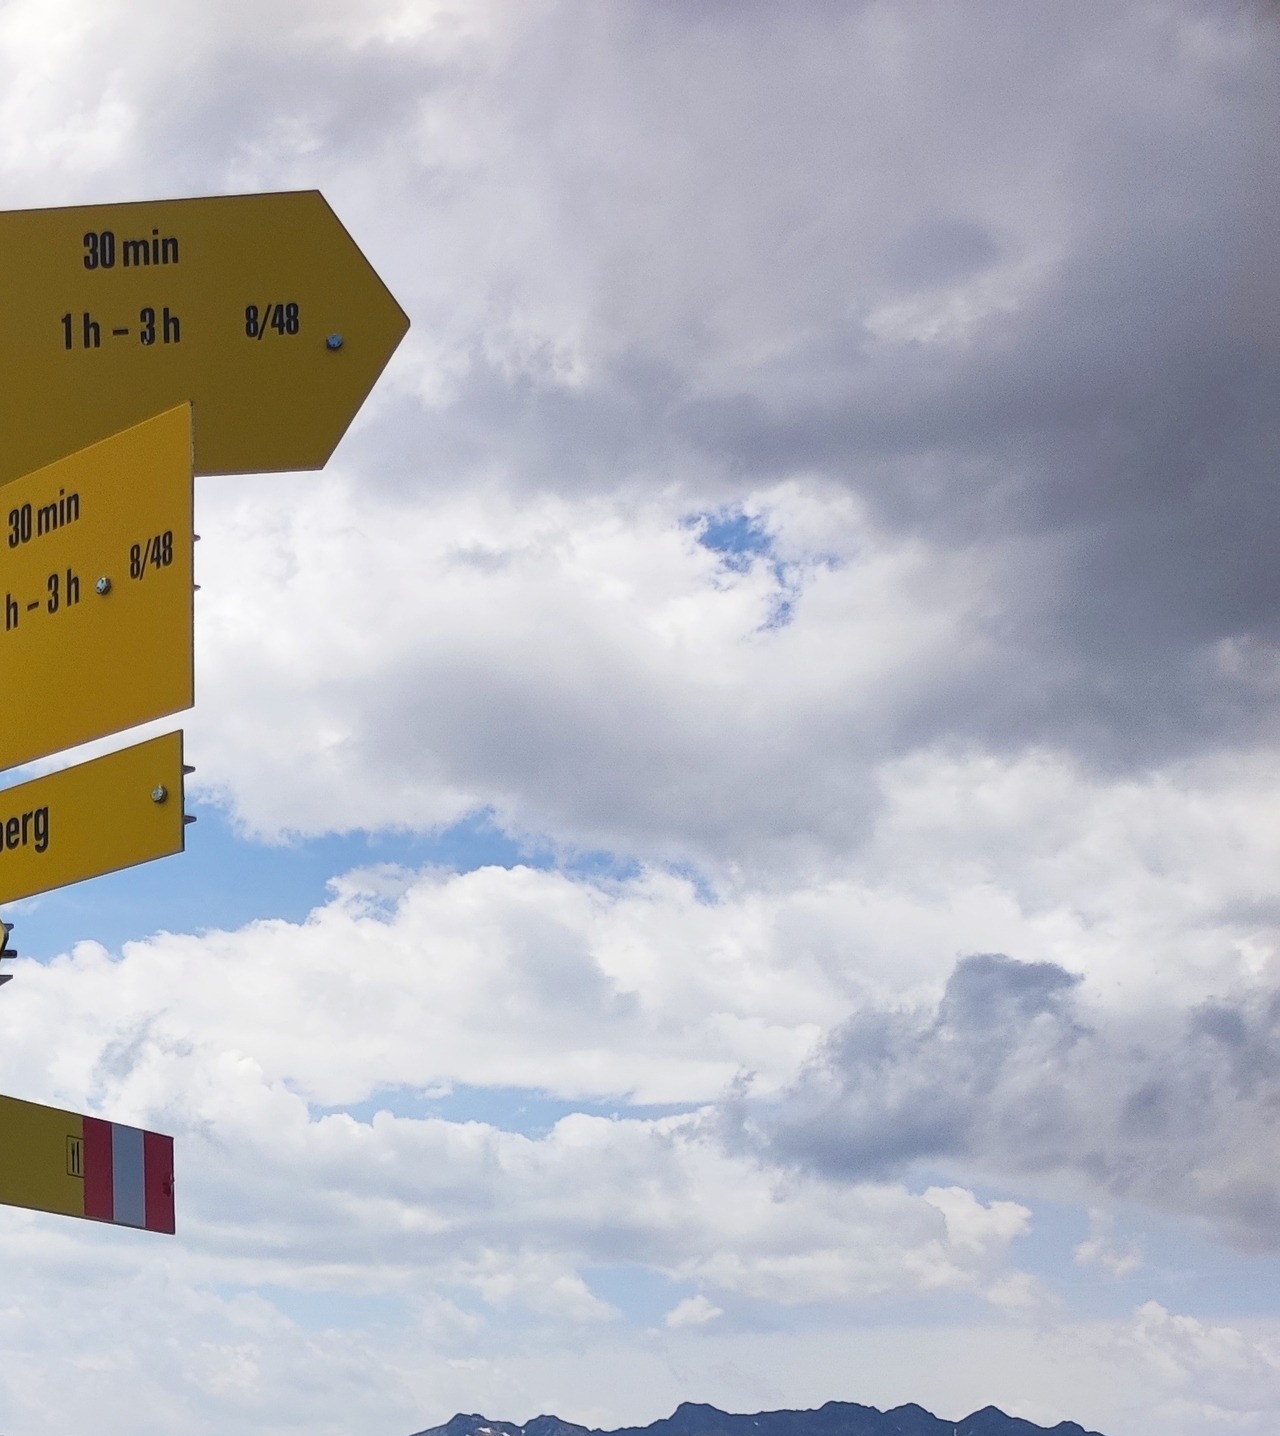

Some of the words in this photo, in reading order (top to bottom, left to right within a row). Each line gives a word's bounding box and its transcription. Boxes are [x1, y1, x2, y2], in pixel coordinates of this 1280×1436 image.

[84, 232, 115, 269] 30
[123, 229, 178, 266] min
[246, 303, 299, 340] 8/48
[9, 504, 31, 547] 30
[38, 489, 79, 536] min
[130, 531, 172, 580] 8/48
